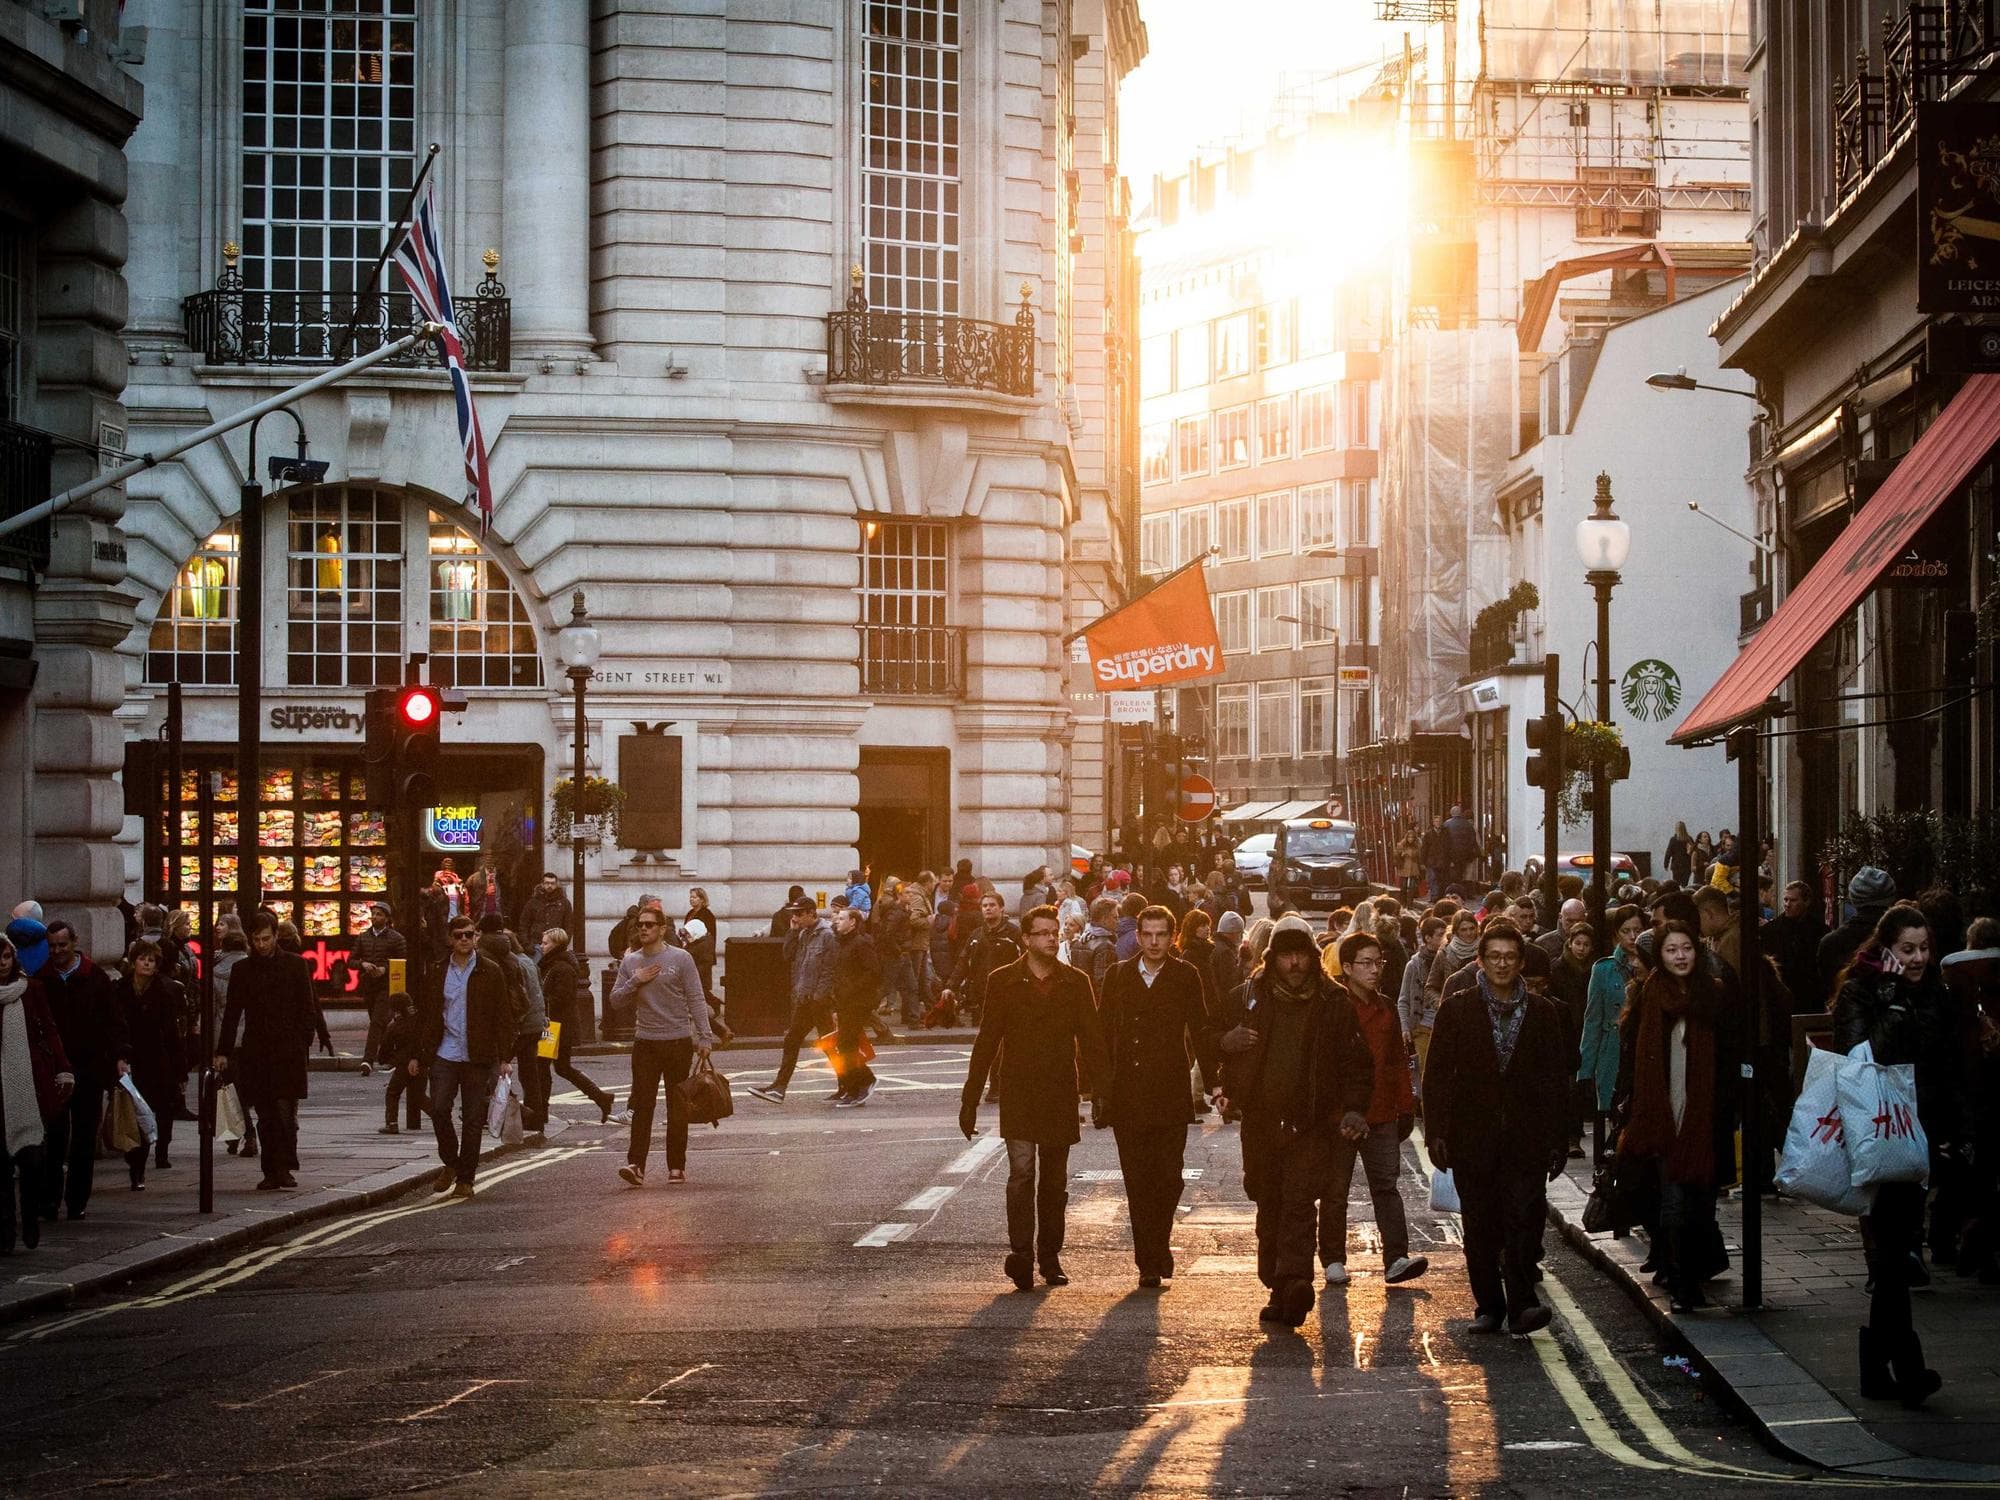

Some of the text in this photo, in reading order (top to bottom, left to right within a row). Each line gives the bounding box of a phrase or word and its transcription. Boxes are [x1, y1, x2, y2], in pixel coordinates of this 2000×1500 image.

[1889, 559, 1949, 577] ndo's
[1096, 643, 1215, 683] Superdry
[588, 671, 633, 683] GENT
[644, 671, 695, 684] STREET
[270, 707, 366, 734] Superdry
[435, 806, 477, 820] T-SHIRT
[1871, 1099, 1916, 1142] H&M
